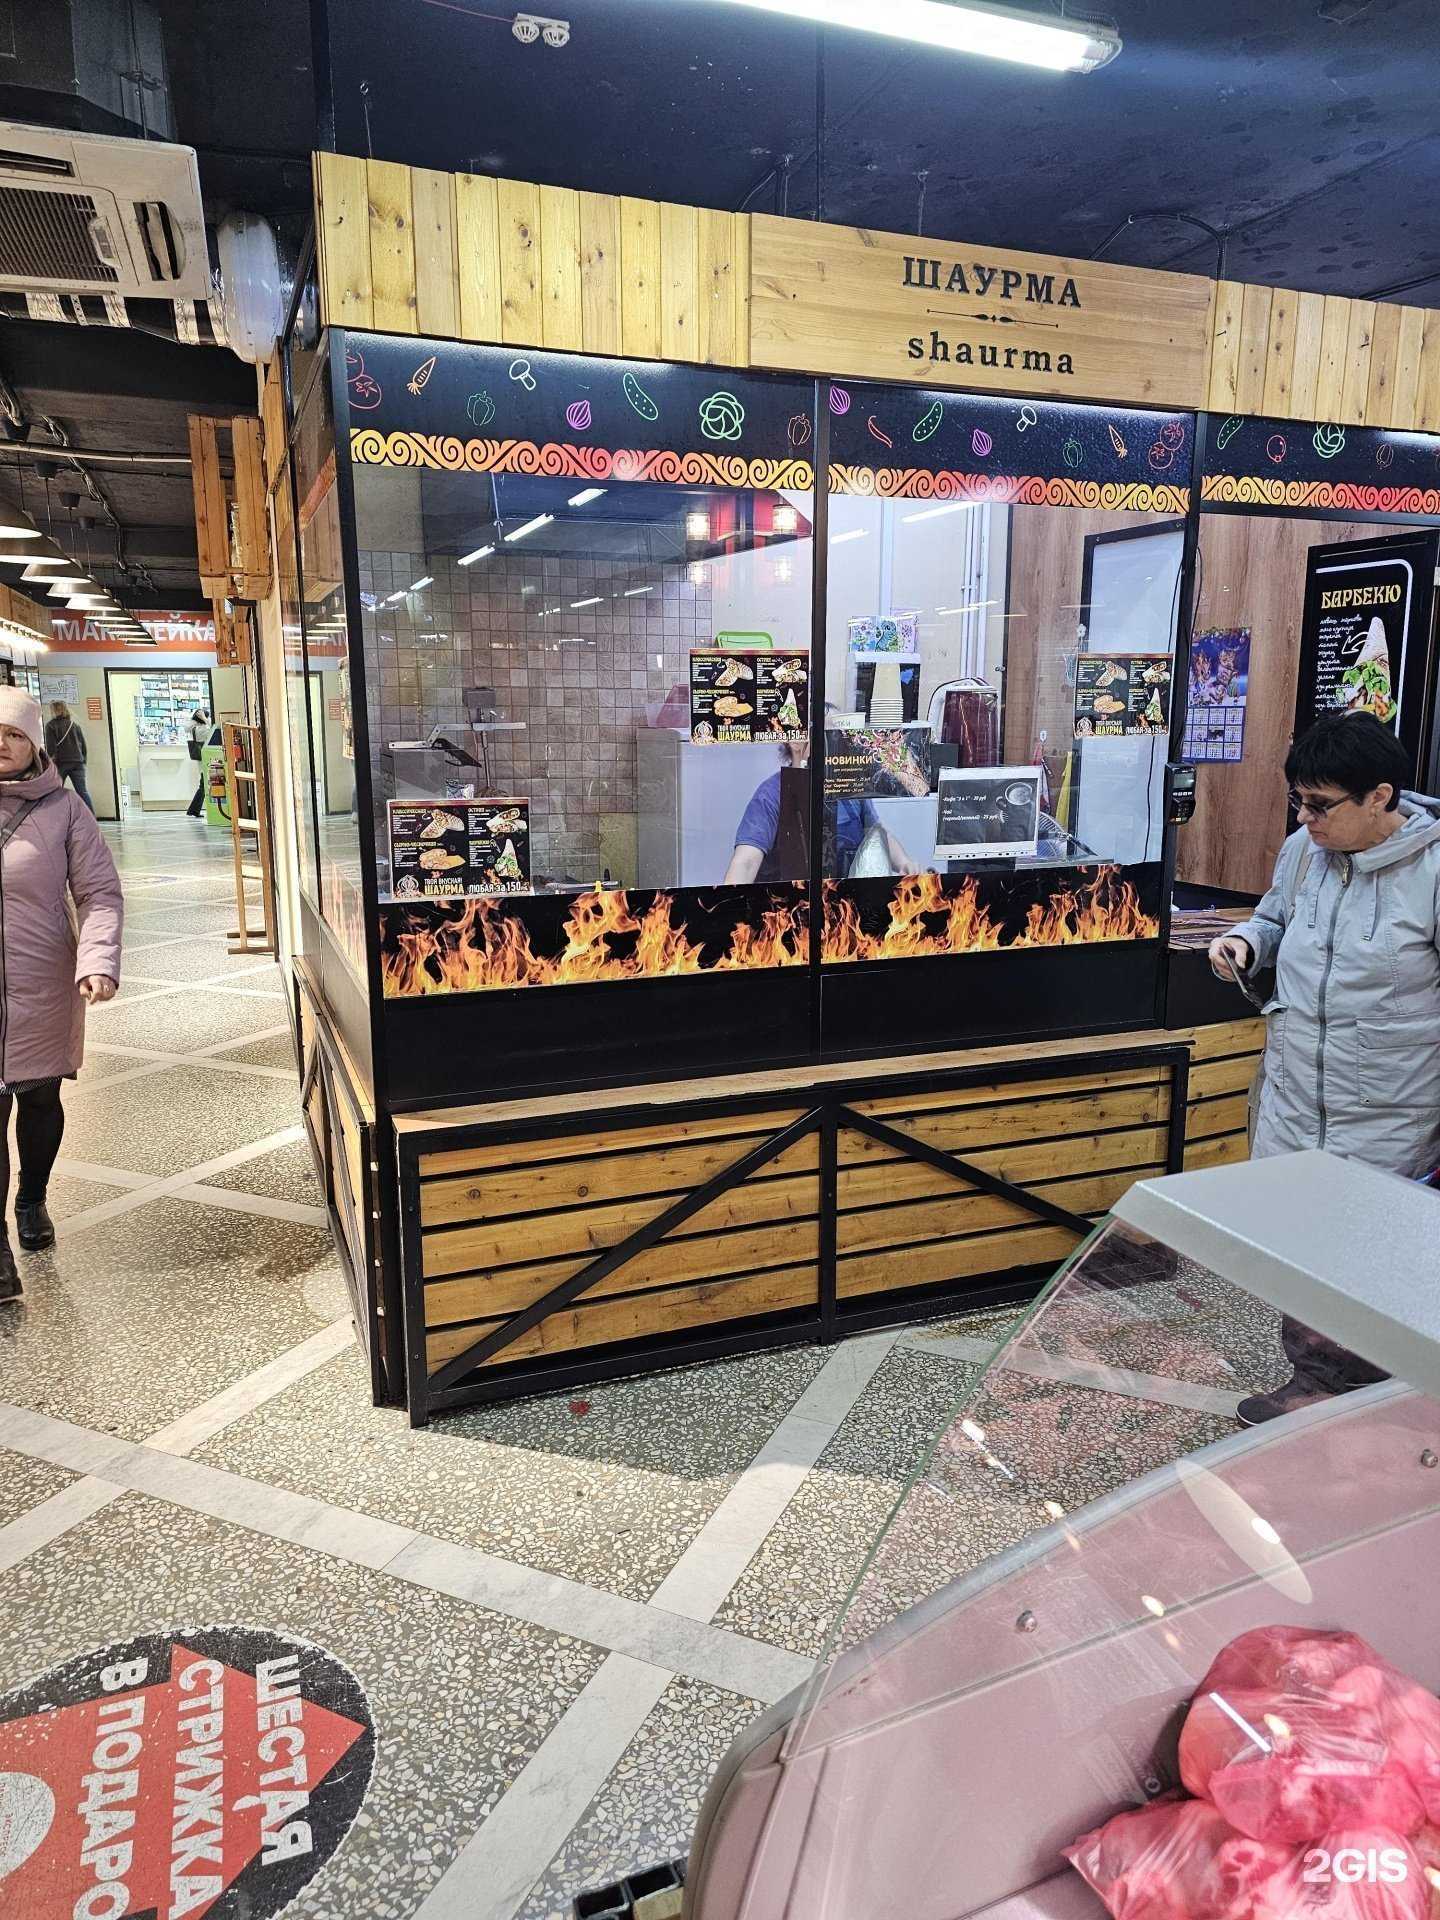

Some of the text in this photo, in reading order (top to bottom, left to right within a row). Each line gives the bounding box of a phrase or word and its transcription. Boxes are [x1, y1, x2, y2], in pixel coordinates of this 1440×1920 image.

[902, 256, 1082, 308] ШАУРМА
[908, 331, 1074, 375] shaurma
[1320, 584, 1402, 609] БАРБЕКЮ
[717, 731, 752, 741] ШАУРМА
[787, 729, 800, 740] 150
[1095, 725, 1123, 735] ШАУРМА
[824, 755, 873, 766] НОВИНКИ
[424, 884, 465, 896] ШАУРМА
[468, 883, 494, 894] ЛЮБАЯ
[494, 884, 506, 893] за
[506, 881, 521, 892] 150
[100, 1657, 149, 1692] В
[255, 1654, 313, 1866] ШЕСТАЯ
[168, 1659, 225, 1920] СТРИЖКА
